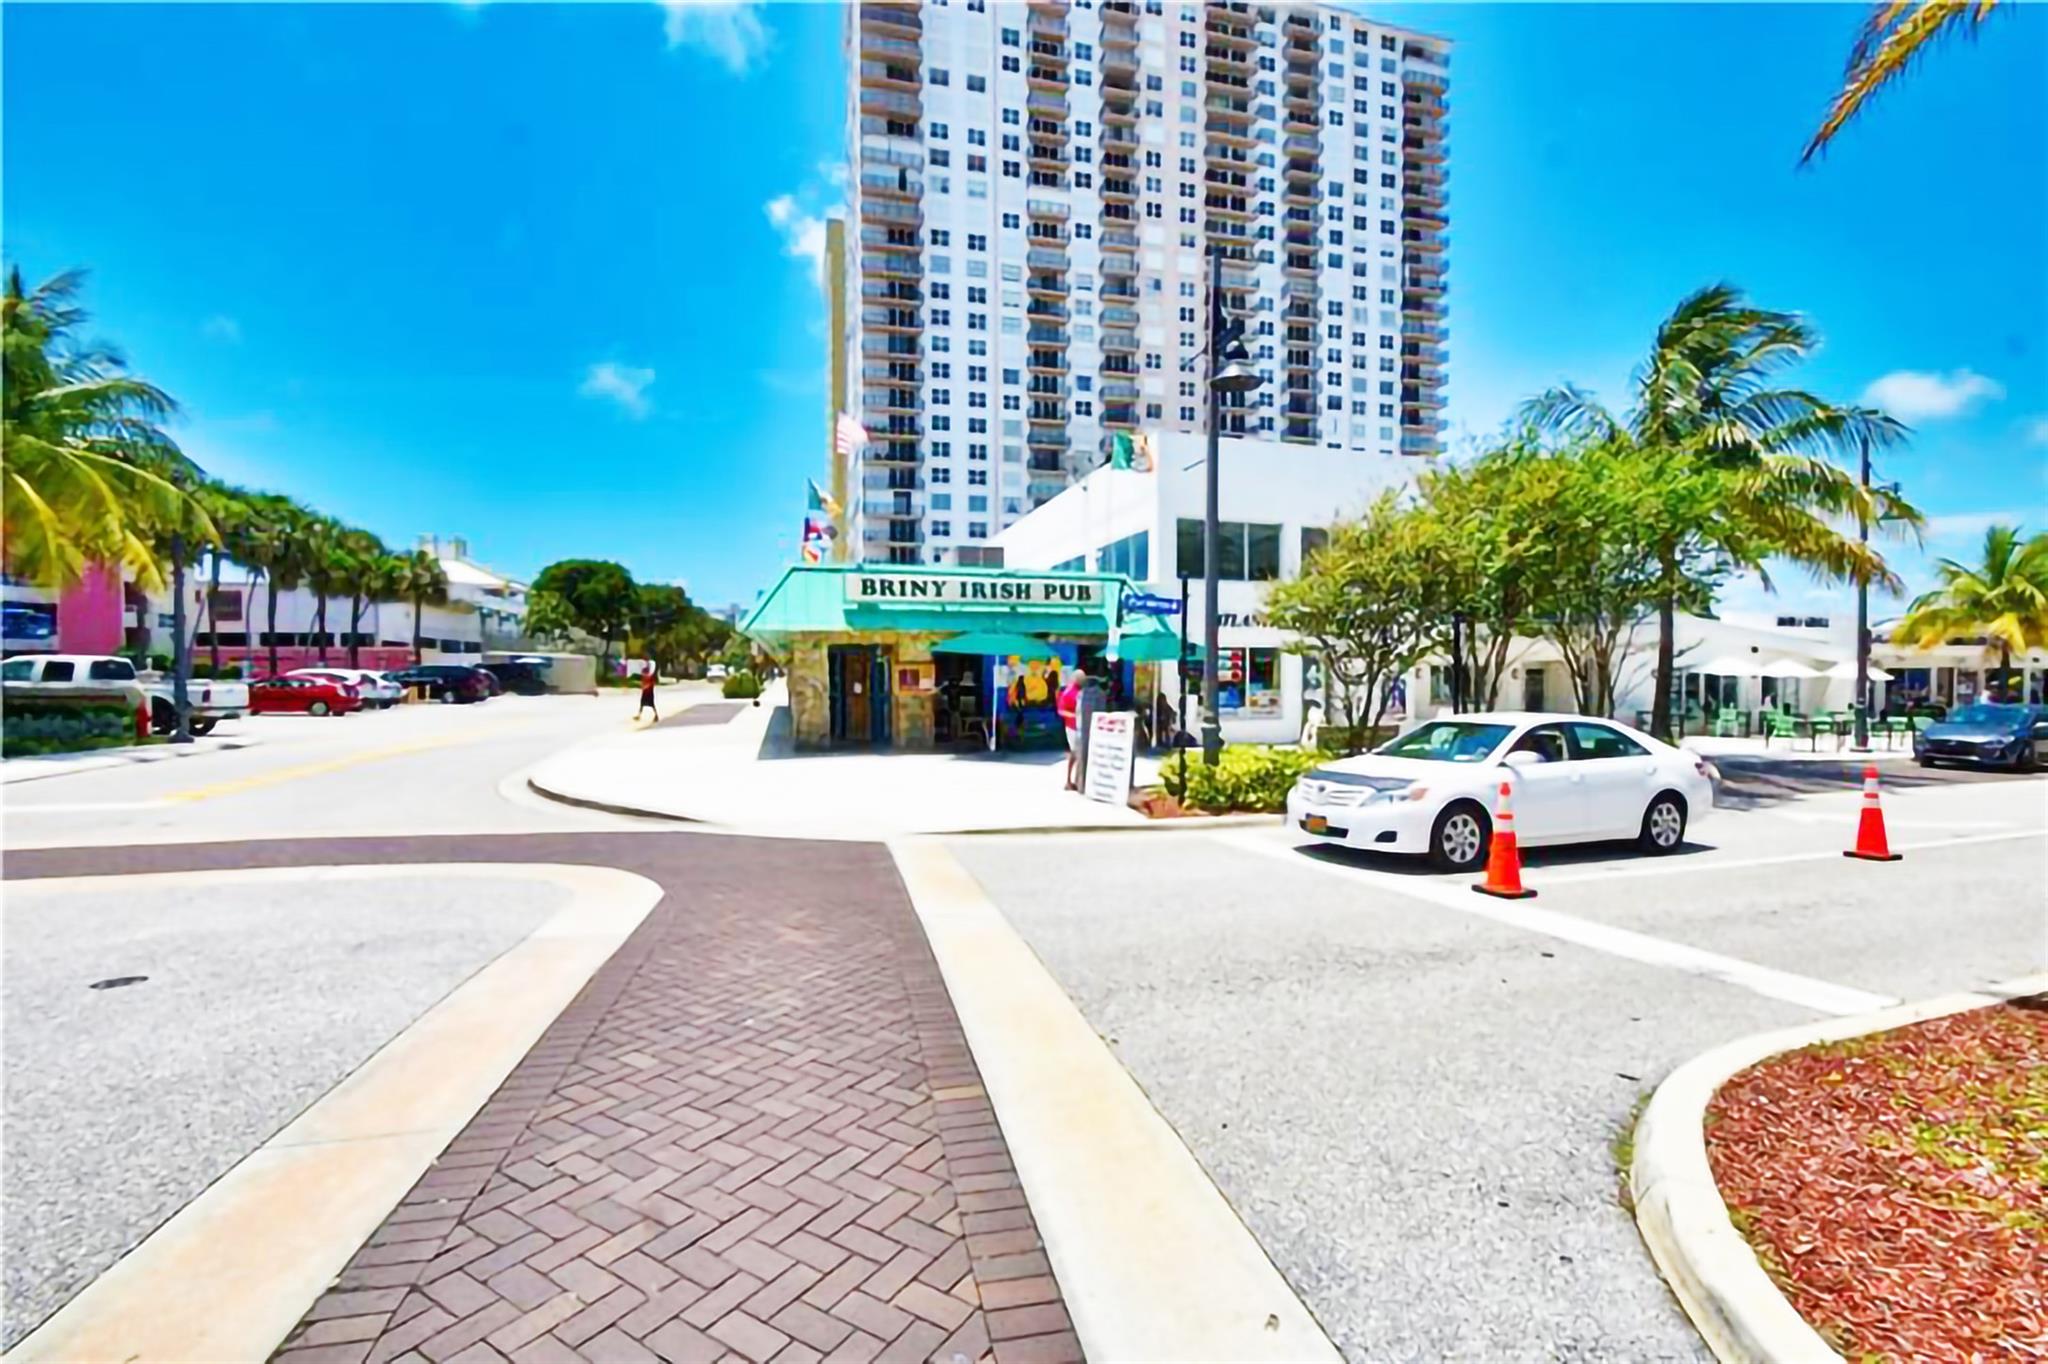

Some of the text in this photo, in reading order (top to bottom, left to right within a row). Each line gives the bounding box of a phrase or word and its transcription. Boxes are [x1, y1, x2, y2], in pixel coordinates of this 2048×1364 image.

[861, 578, 1092, 601] BRINY IRISH PUB
